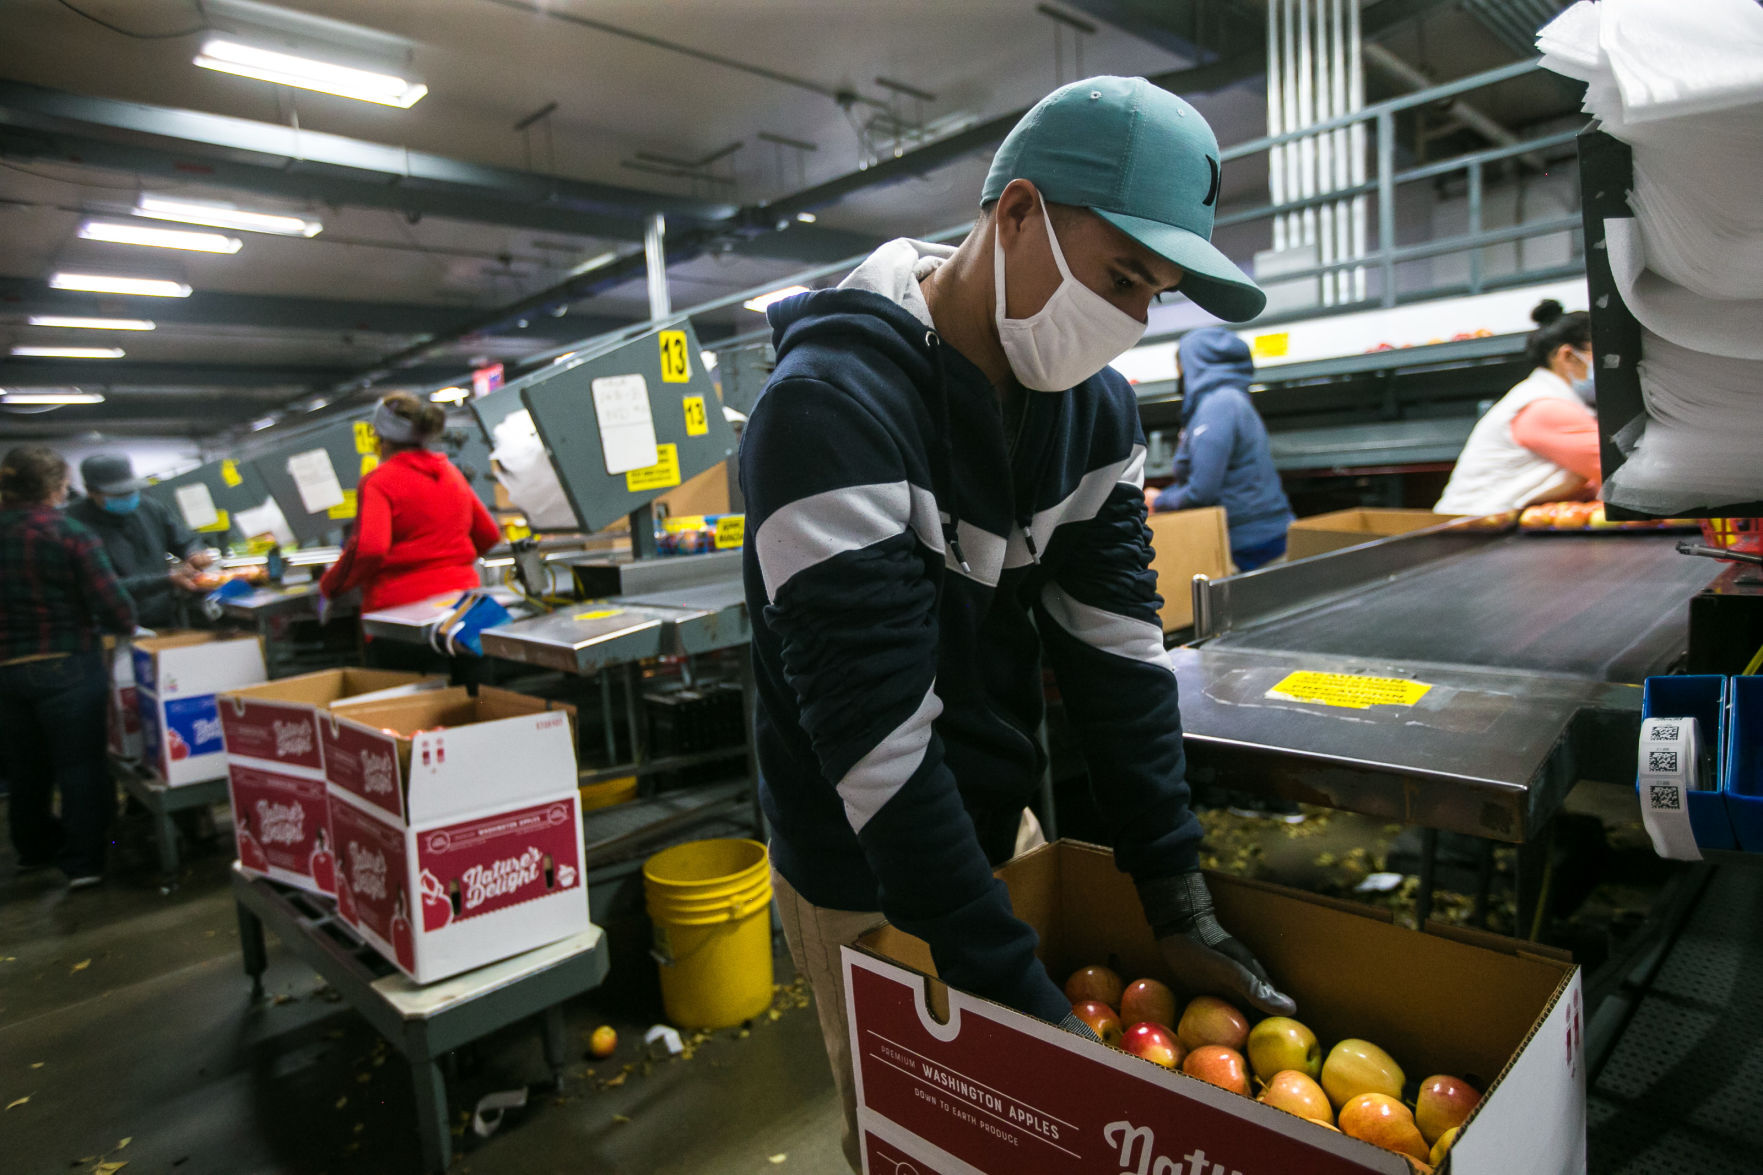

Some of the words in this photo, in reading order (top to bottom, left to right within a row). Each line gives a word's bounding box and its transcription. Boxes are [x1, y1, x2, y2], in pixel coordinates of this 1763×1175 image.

[661, 337, 685, 375] 13
[686, 402, 705, 425] 13
[466, 863, 539, 909] Delight
[880, 1045, 916, 1069] PREMIUM
[921, 1063, 1003, 1113] WASHINGTON
[1009, 1105, 1060, 1140] APPLES
[914, 1087, 937, 1105] DOWN
[940, 1100, 950, 1112] TO
[953, 1107, 977, 1126] EARTH
[979, 1120, 1019, 1146] PRODUCE
